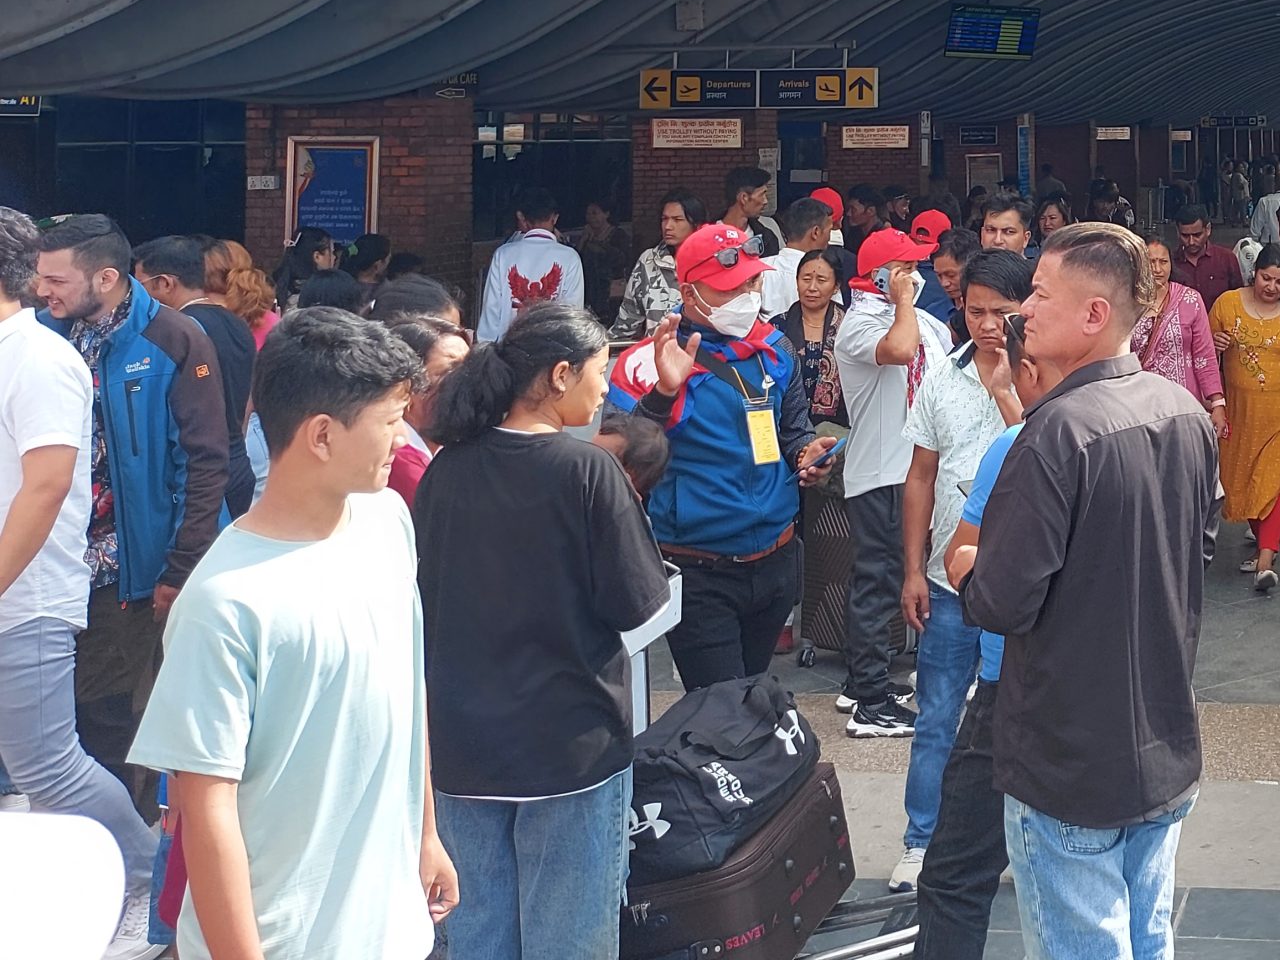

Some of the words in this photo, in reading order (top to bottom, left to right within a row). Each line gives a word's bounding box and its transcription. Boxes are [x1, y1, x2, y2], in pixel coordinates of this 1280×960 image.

[460, 73, 478, 84] CAFE
[706, 80, 751, 90] Departures
[779, 80, 810, 88] Arrivals
[702, 766, 737, 802] UNDER
[711, 762, 754, 806] ARMOUR
[725, 924, 765, 950] LEAVES
